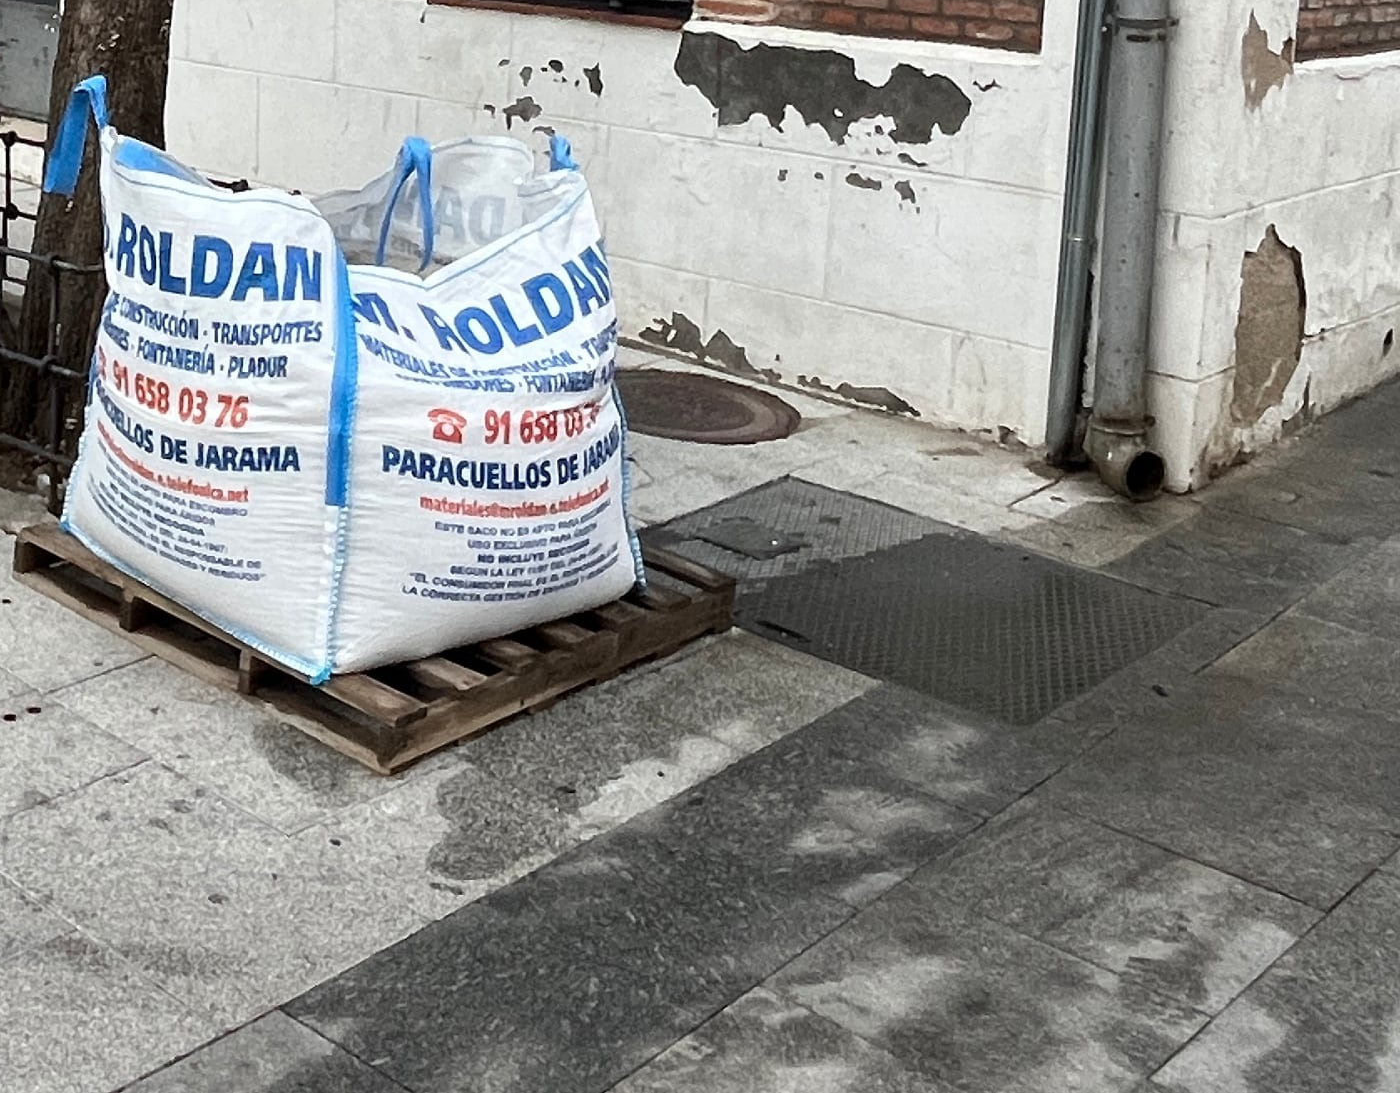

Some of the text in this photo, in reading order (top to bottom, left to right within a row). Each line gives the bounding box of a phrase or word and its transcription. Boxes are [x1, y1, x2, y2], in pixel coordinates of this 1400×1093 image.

[116, 212, 322, 302] ROLDAN
[417, 242, 610, 357] ROLDAN
[212, 321, 323, 346] TRANSPORTES
[227, 355, 288, 379] PLADUR
[113, 359, 249, 428] 91 658 03 76
[484, 409, 511, 445] 91
[519, 410, 558, 445] 658
[160, 434, 189, 464] DE
[195, 443, 301, 472] JARAMA
[382, 444, 552, 491] PARACUELLOS
[557, 453, 579, 486] DE
[435, 521, 465, 534] ESTE
